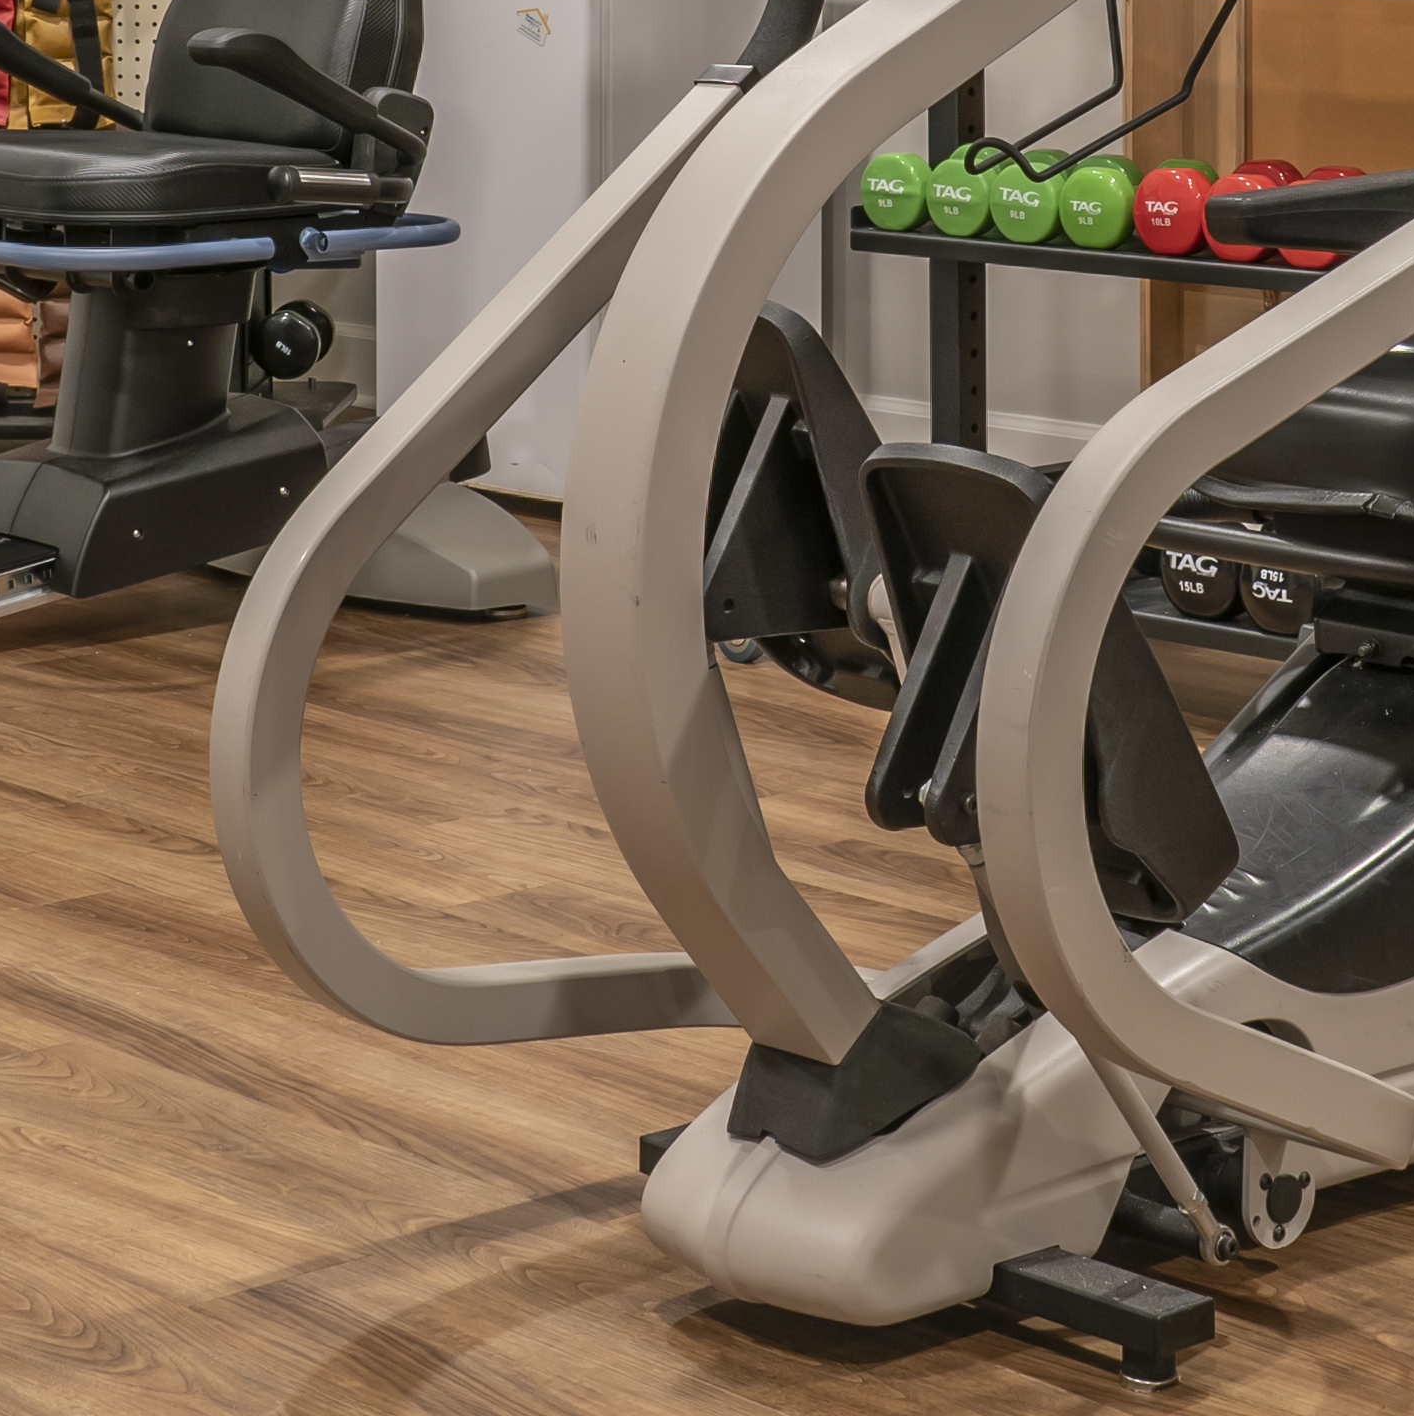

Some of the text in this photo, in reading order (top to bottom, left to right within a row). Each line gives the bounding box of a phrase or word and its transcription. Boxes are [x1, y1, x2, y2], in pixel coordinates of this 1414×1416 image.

[867, 177, 905, 195] TAG
[932, 183, 972, 202] TAG
[998, 186, 1041, 208] TAG
[1069, 200, 1102, 215] TAG
[1144, 200, 1179, 215] TAG
[1151, 217, 1172, 227] 10LB
[1165, 550, 1218, 577] TAG
[1260, 568, 1285, 583] 15LB
[1178, 580, 1205, 594] 15LB
[1251, 581, 1293, 603] TAG
